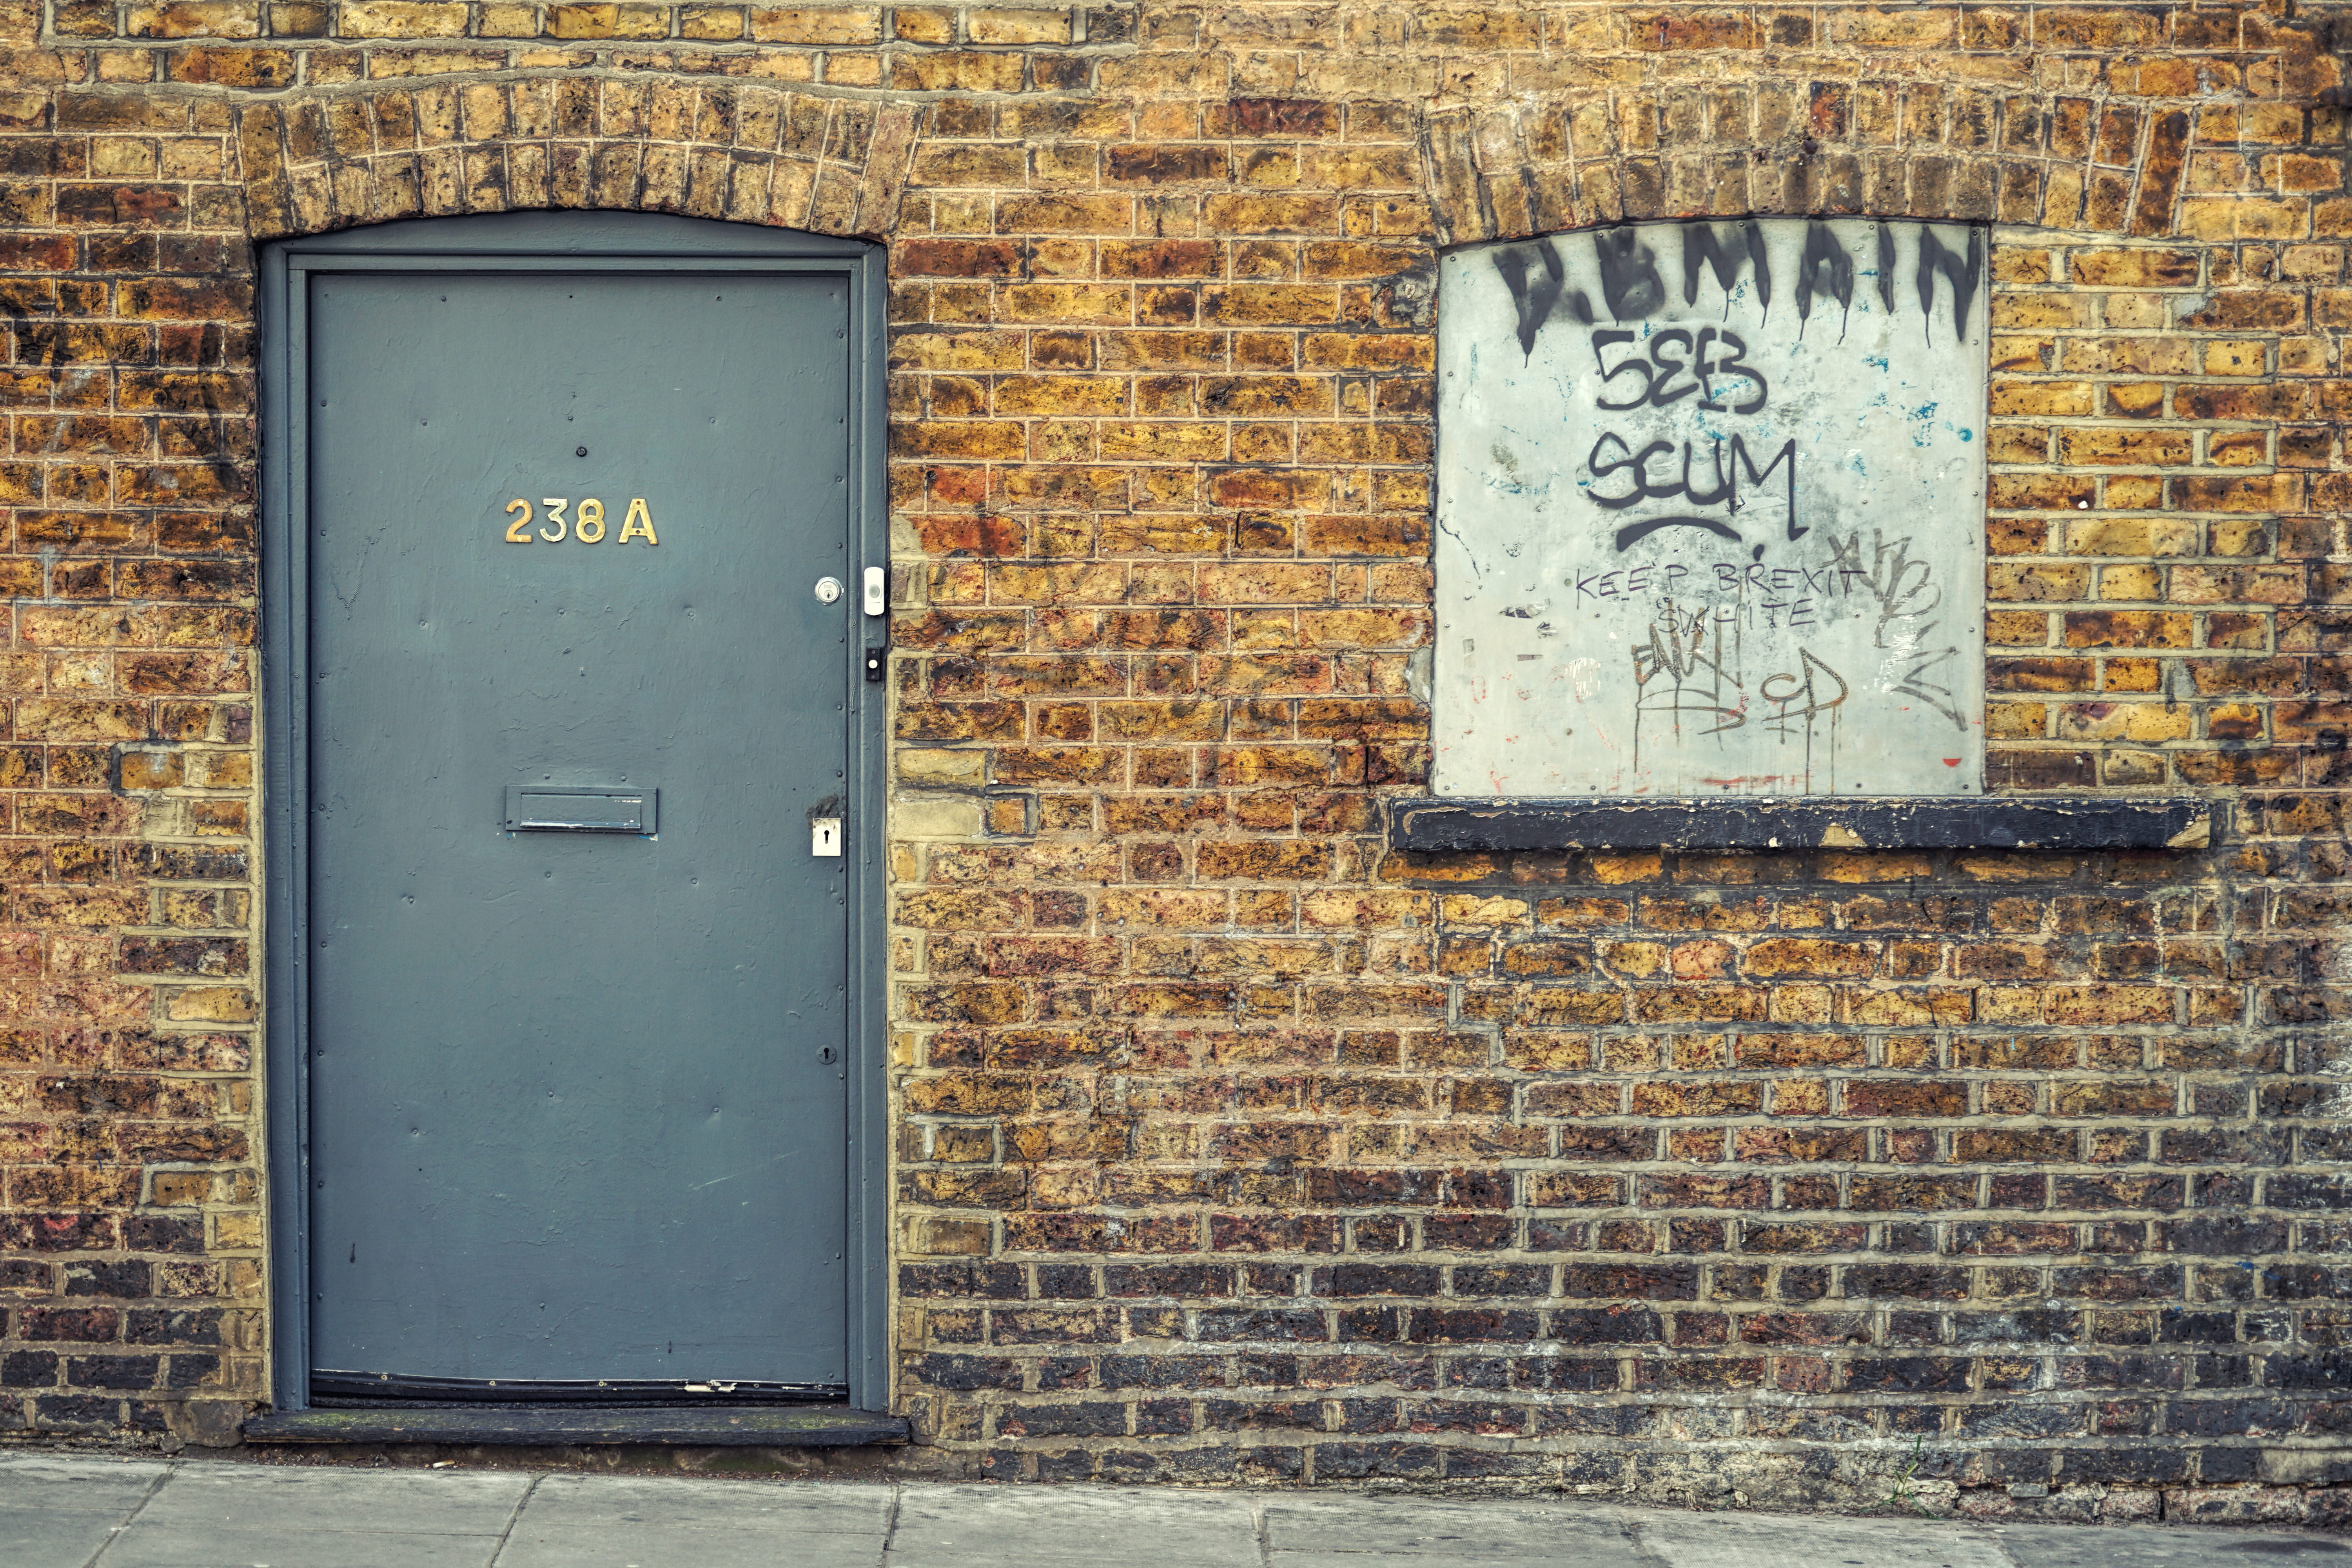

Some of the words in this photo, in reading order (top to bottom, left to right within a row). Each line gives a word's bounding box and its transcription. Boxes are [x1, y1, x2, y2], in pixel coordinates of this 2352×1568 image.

[1588, 432, 1809, 541] SCUM
[1576, 564, 1689, 610] KEEP
[1712, 563, 1867, 599] BREXIT
